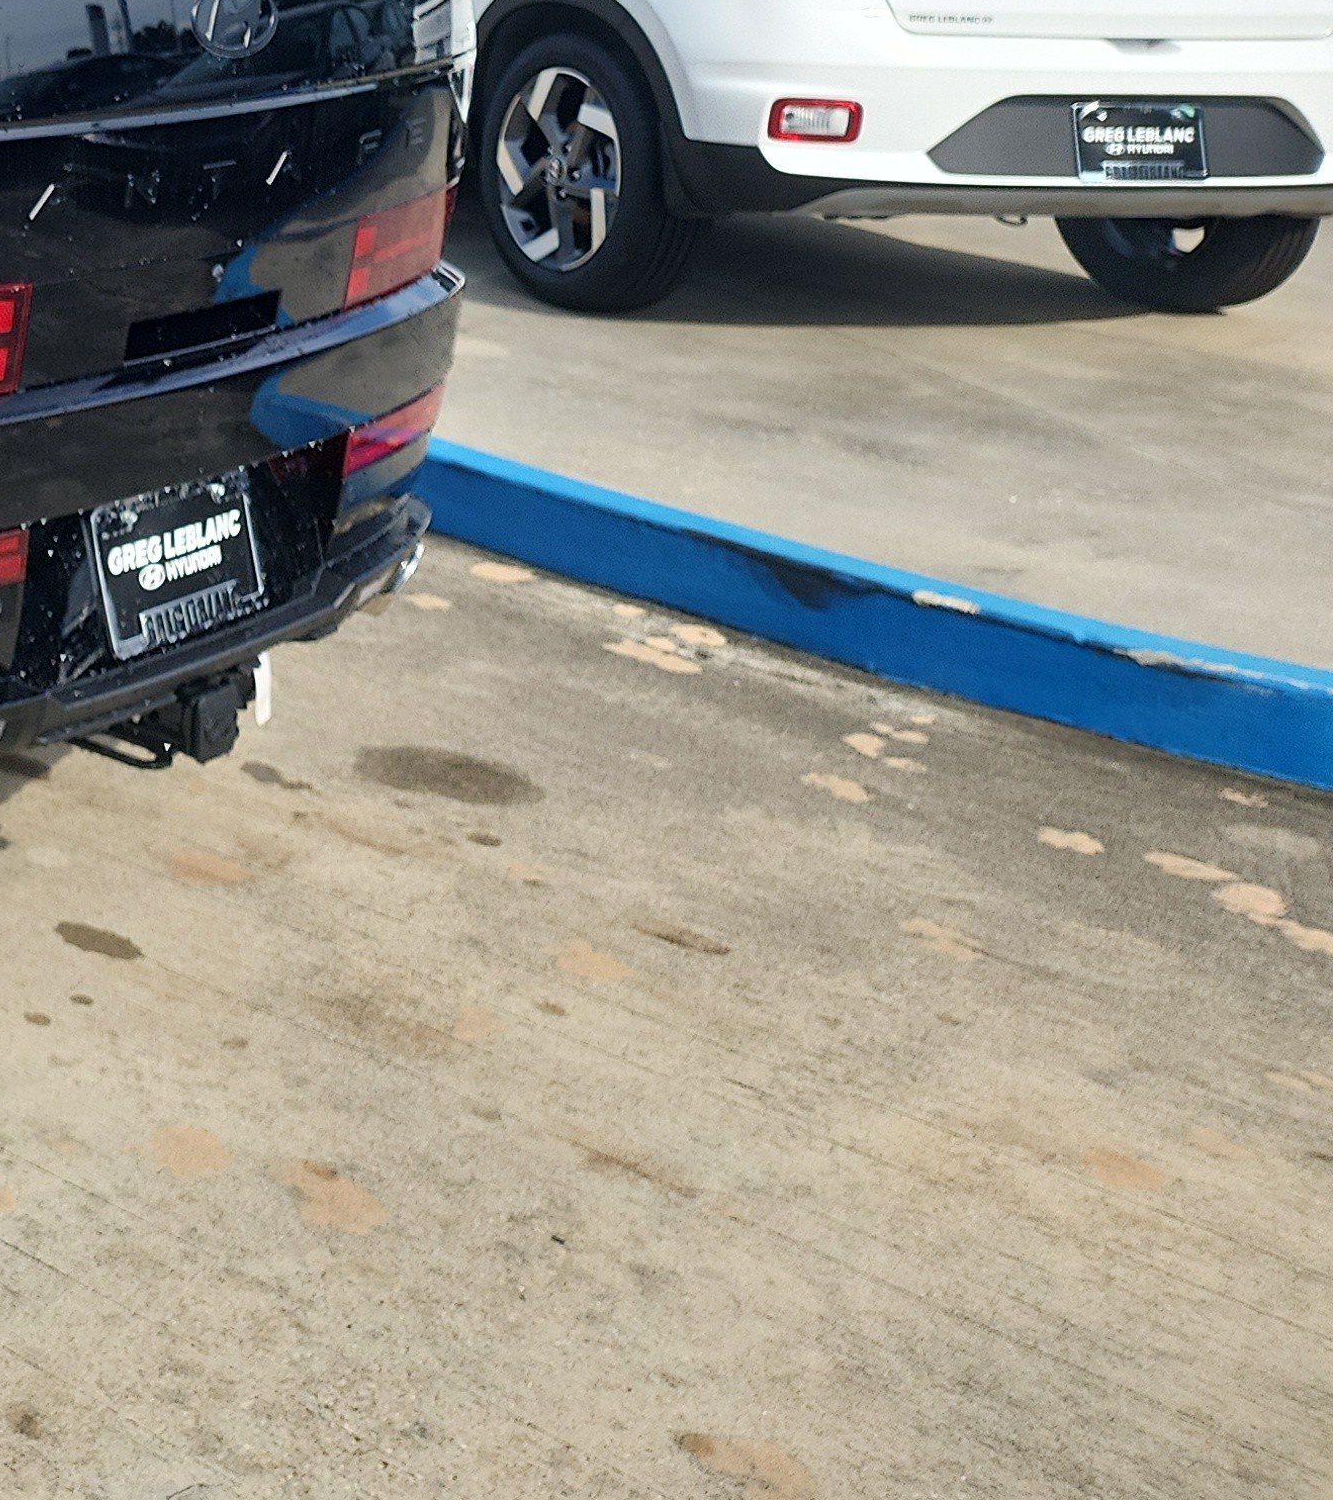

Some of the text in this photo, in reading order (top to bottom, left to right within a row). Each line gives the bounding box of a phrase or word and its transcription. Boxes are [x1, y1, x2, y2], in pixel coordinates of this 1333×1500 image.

[1082, 126, 1195, 143] GREG LEBLANC
[1127, 144, 1174, 155] HYUNDAI
[107, 509, 241, 576] GREG LEBLANC
[165, 545, 222, 582] HYUNDAI
